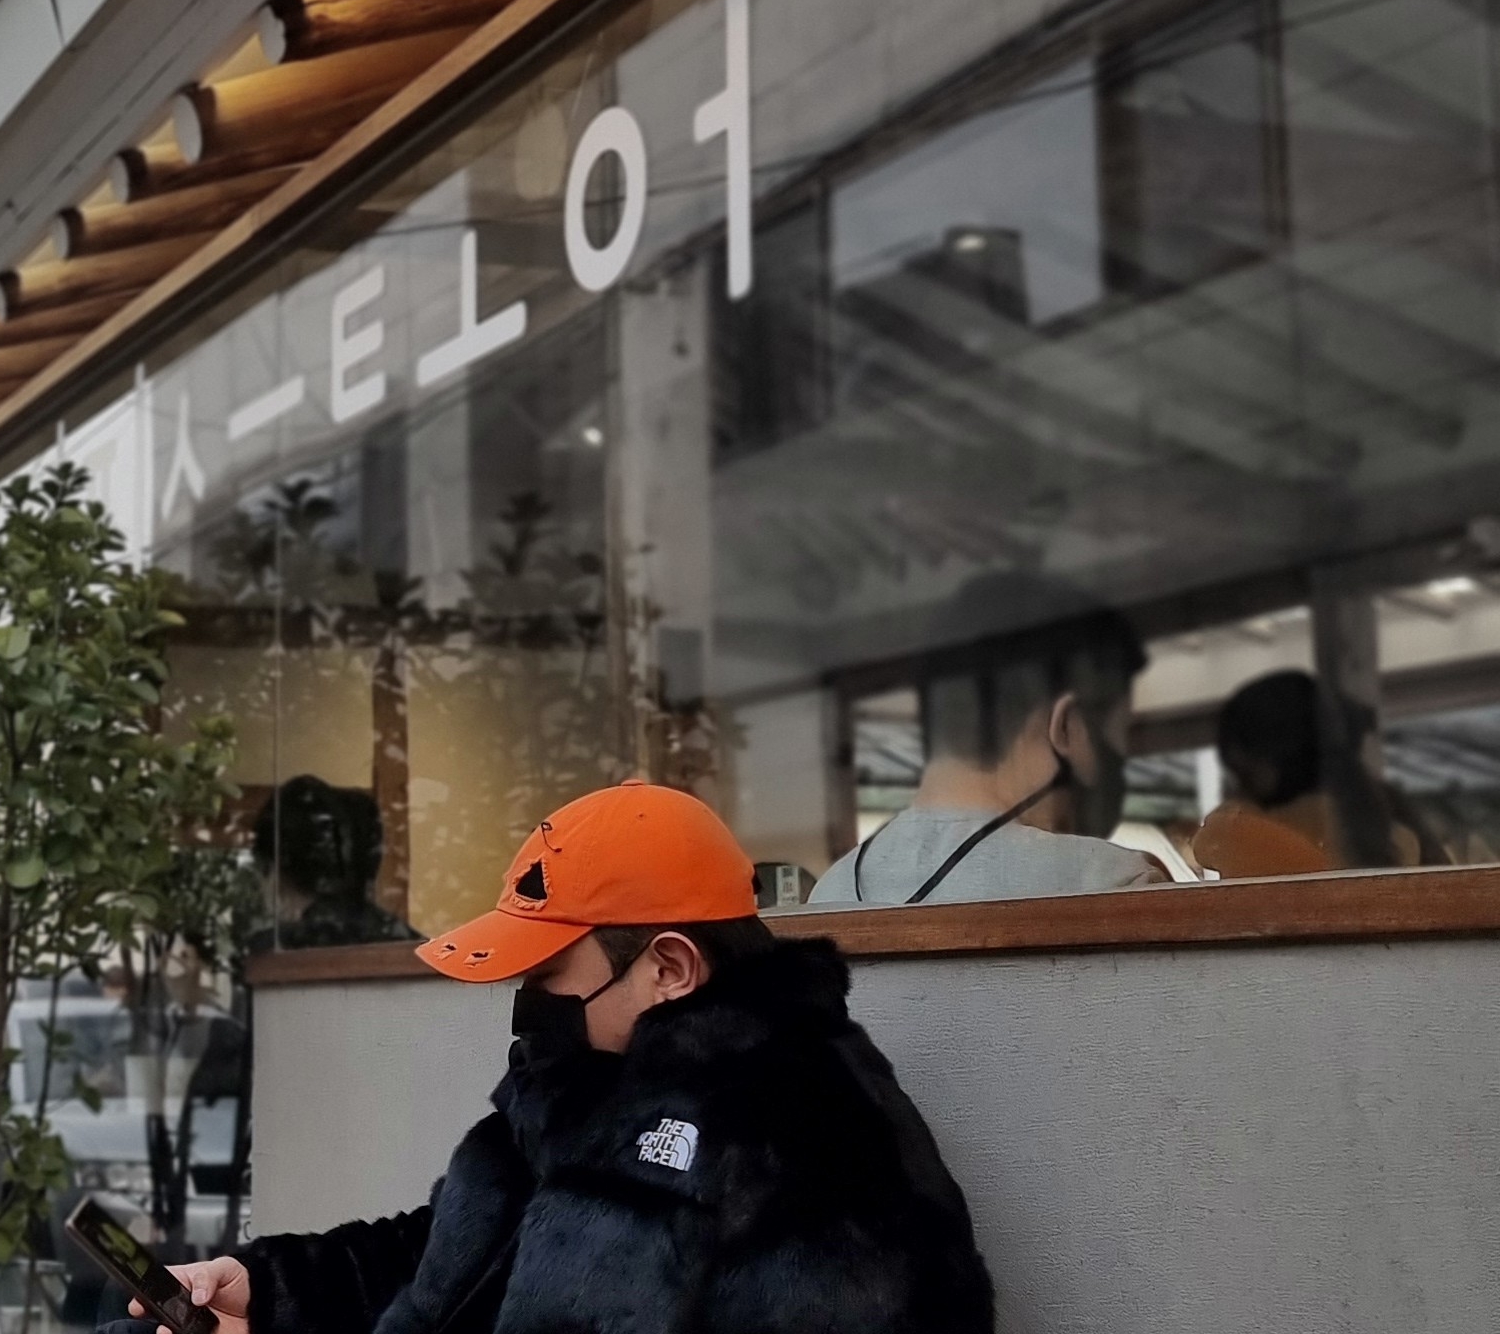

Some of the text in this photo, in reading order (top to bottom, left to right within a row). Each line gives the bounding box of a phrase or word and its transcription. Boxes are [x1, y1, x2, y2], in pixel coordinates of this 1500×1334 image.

[656, 1118, 685, 1134] THE
[635, 1131, 678, 1151] NORTH
[637, 1146, 672, 1165] FACE
